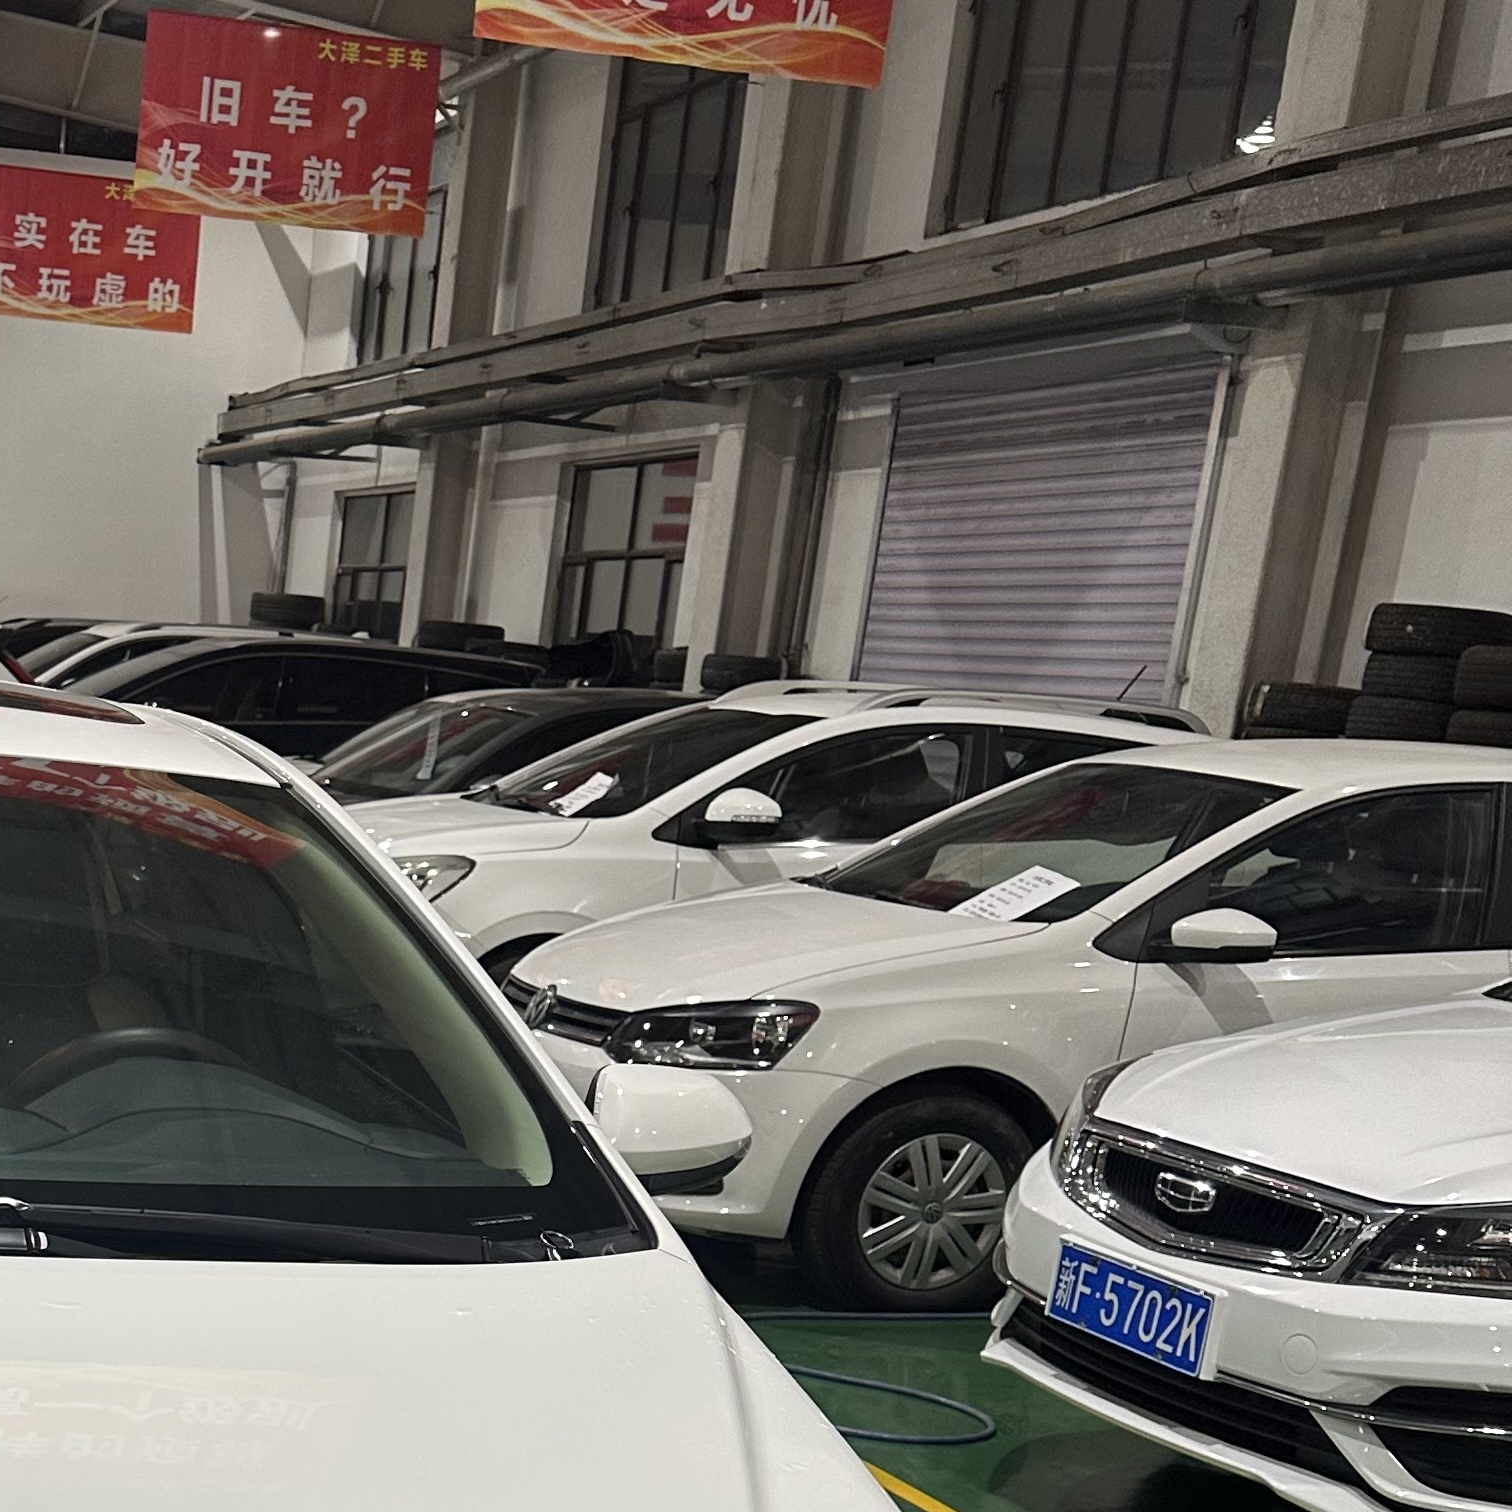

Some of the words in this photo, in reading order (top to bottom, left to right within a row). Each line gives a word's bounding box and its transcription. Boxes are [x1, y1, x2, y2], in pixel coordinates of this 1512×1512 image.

[317, 39, 428, 71] 大泽二手车
[157, 138, 413, 212] 好开就行
[14, 213, 157, 261] 实在车
